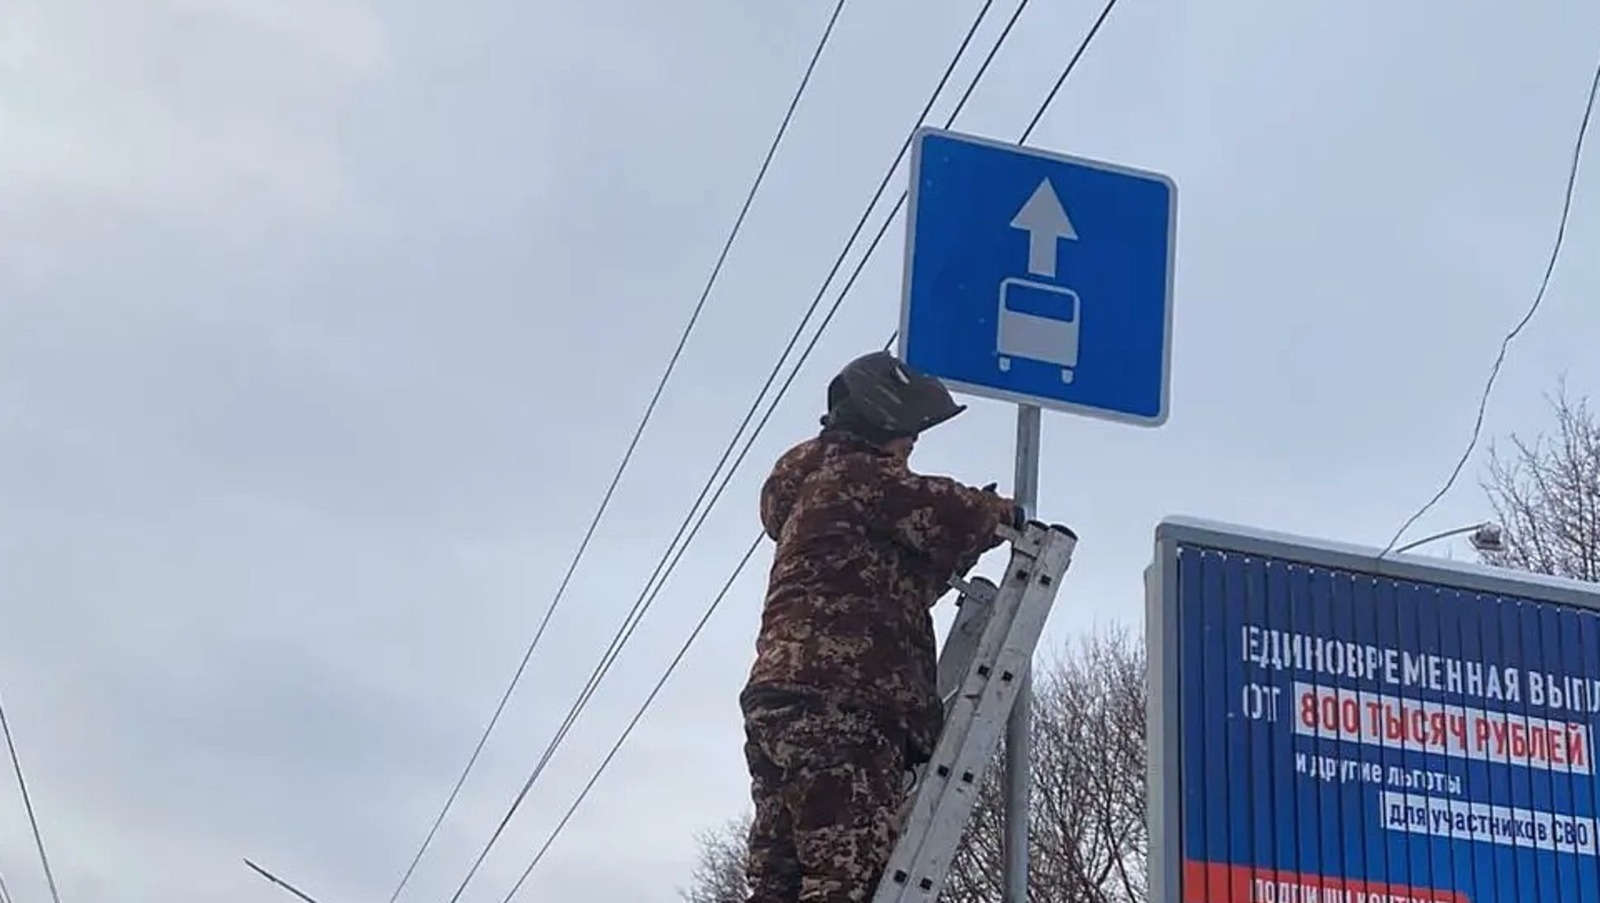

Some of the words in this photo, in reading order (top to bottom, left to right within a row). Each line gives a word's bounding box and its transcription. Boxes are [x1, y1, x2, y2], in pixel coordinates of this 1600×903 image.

[1243, 625, 1519, 702] ЕДИНОВРЕМЕННАЯ
[1242, 683, 1280, 722] ОТ
[1302, 692, 1359, 733] 800
[1367, 702, 1466, 750] ТЫСЯЧ
[1475, 717, 1584, 766] РУБЛЕЙ
[1296, 752, 1306, 773] и
[1310, 755, 1382, 784] другие
[1388, 766, 1461, 795] льготы
[1390, 803, 1427, 826] для
[1432, 809, 1548, 842] участников
[1554, 820, 1588, 846] СВО
